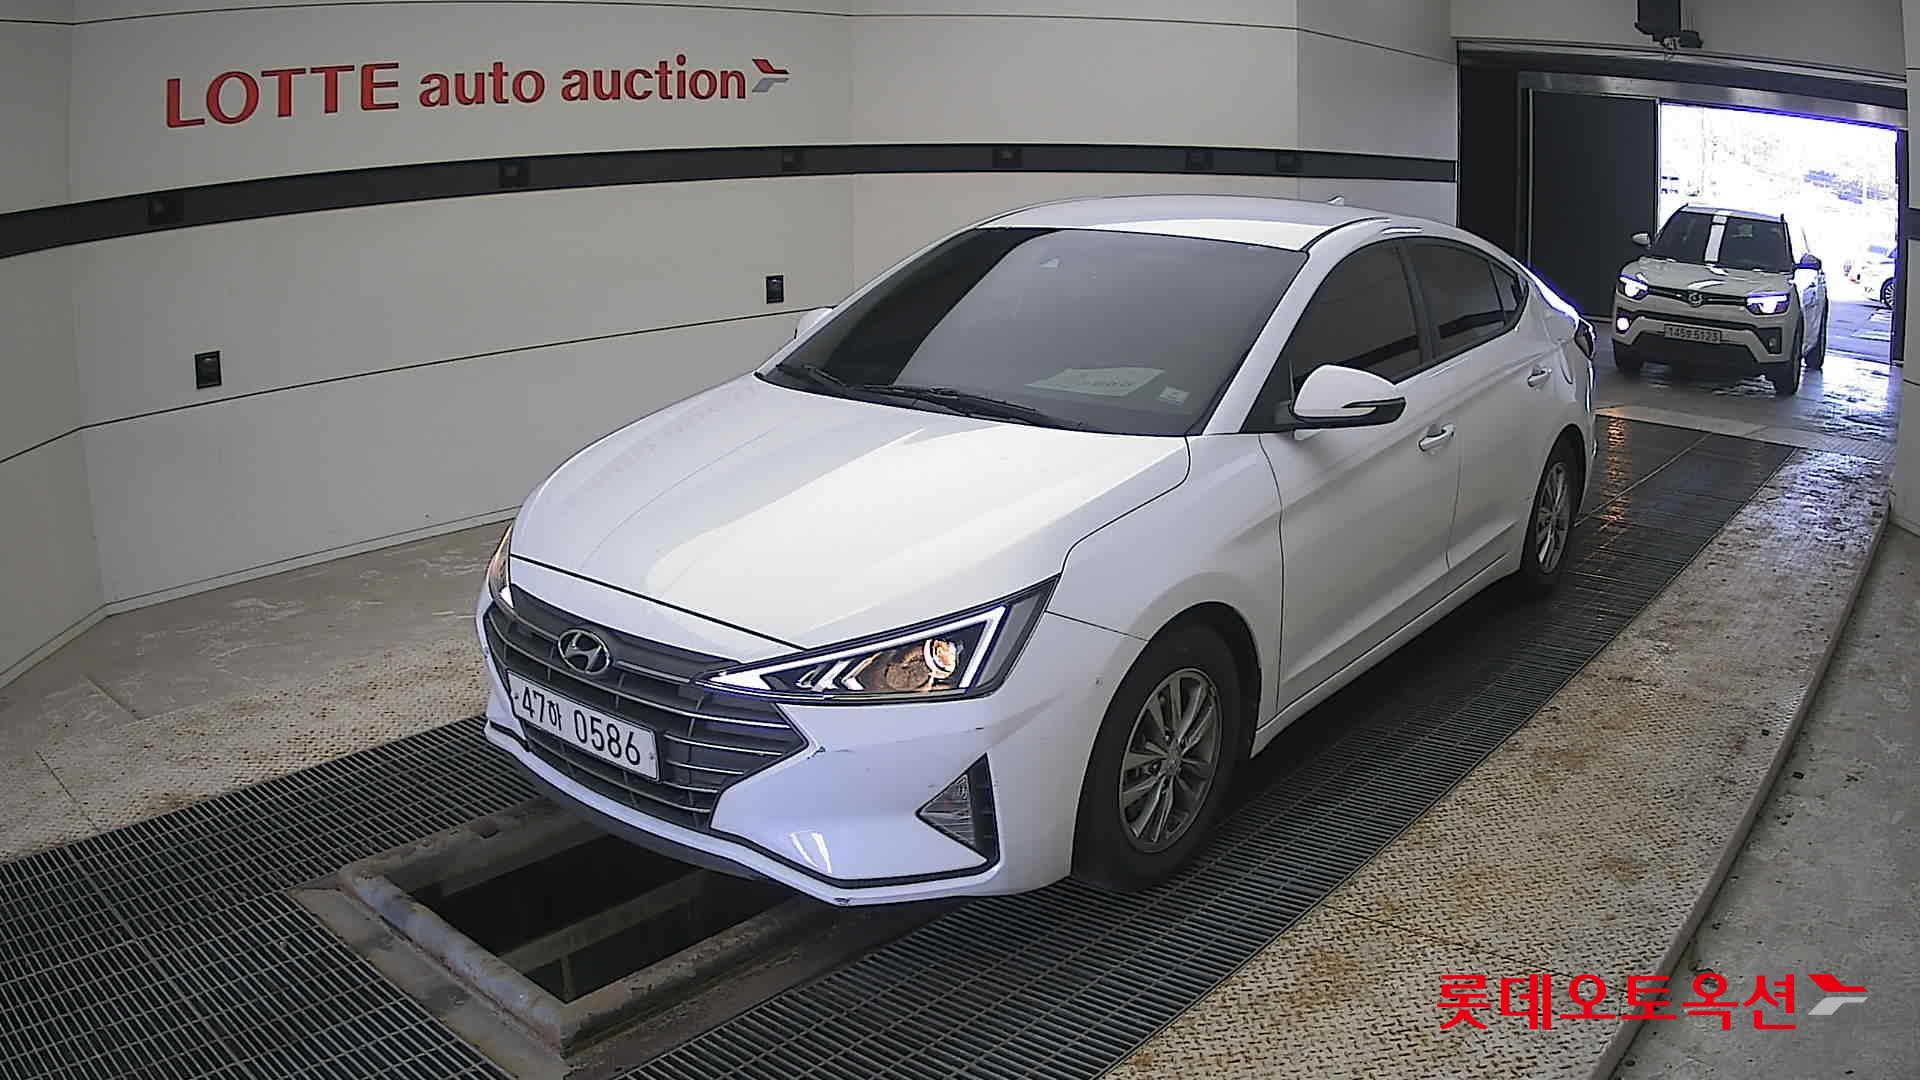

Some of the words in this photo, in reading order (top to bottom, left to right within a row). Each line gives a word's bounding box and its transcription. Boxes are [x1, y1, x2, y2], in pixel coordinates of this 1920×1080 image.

[166, 62, 400, 129] LOTTE
[418, 61, 546, 108] auto
[560, 54, 747, 102] auction
[574, 710, 641, 765] 0586
